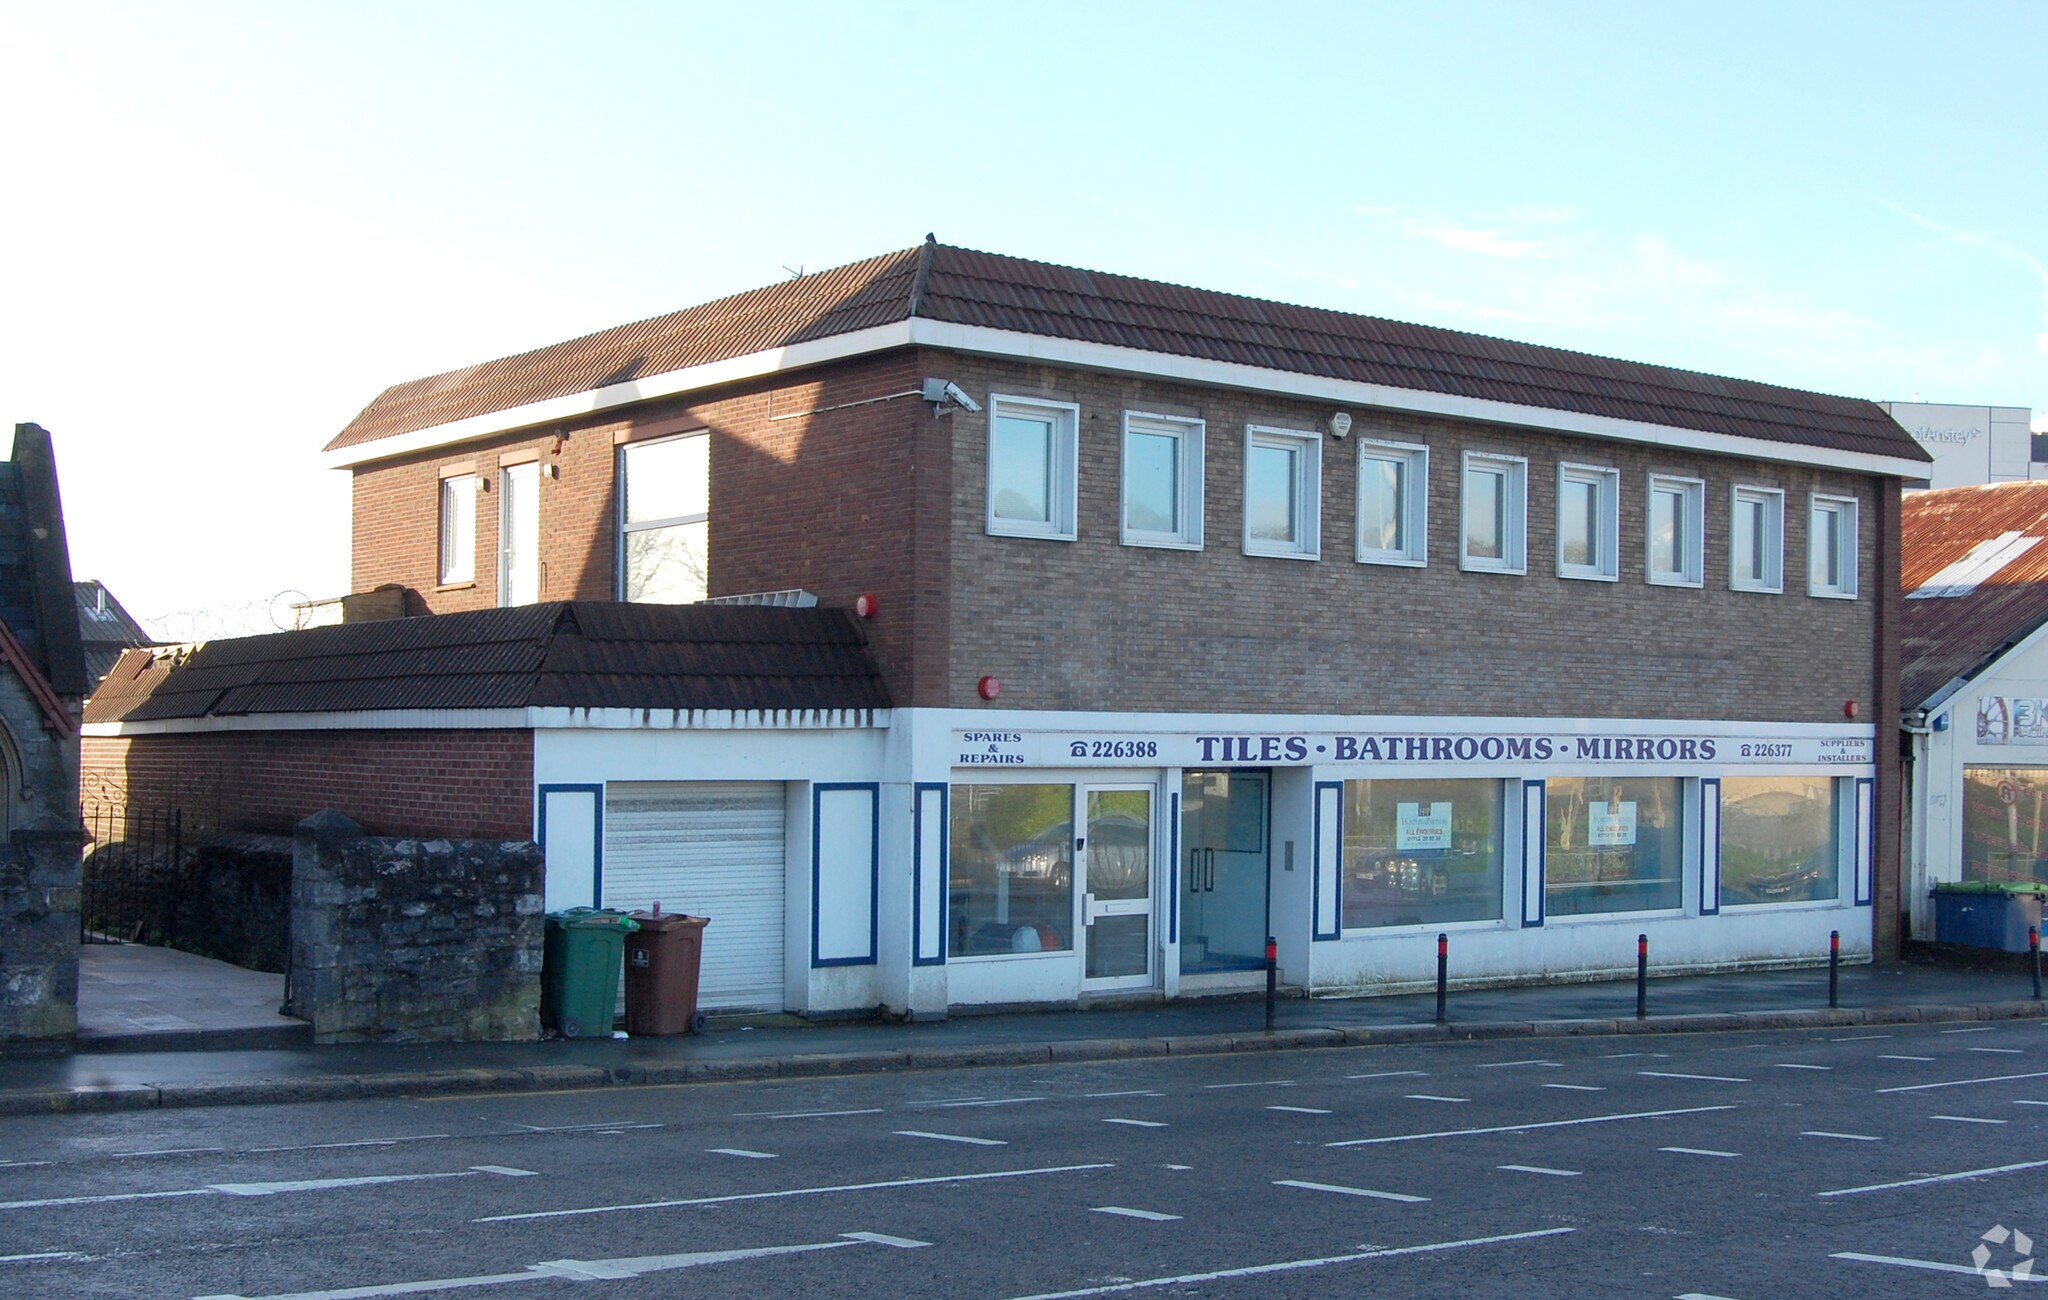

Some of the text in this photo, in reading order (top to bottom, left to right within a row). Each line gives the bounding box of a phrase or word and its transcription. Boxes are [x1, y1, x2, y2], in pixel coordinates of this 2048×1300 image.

[963, 732, 1022, 742] SPARES
[987, 743, 999, 753] &
[1820, 739, 1865, 747] SUPPLIERS
[1092, 740, 1158, 758] 226388
[1195, 736, 1717, 762] TILES BATHROOMS MIRRORS
[1754, 743, 1793, 757] 226377
[959, 754, 1025, 764] REPAIRS
